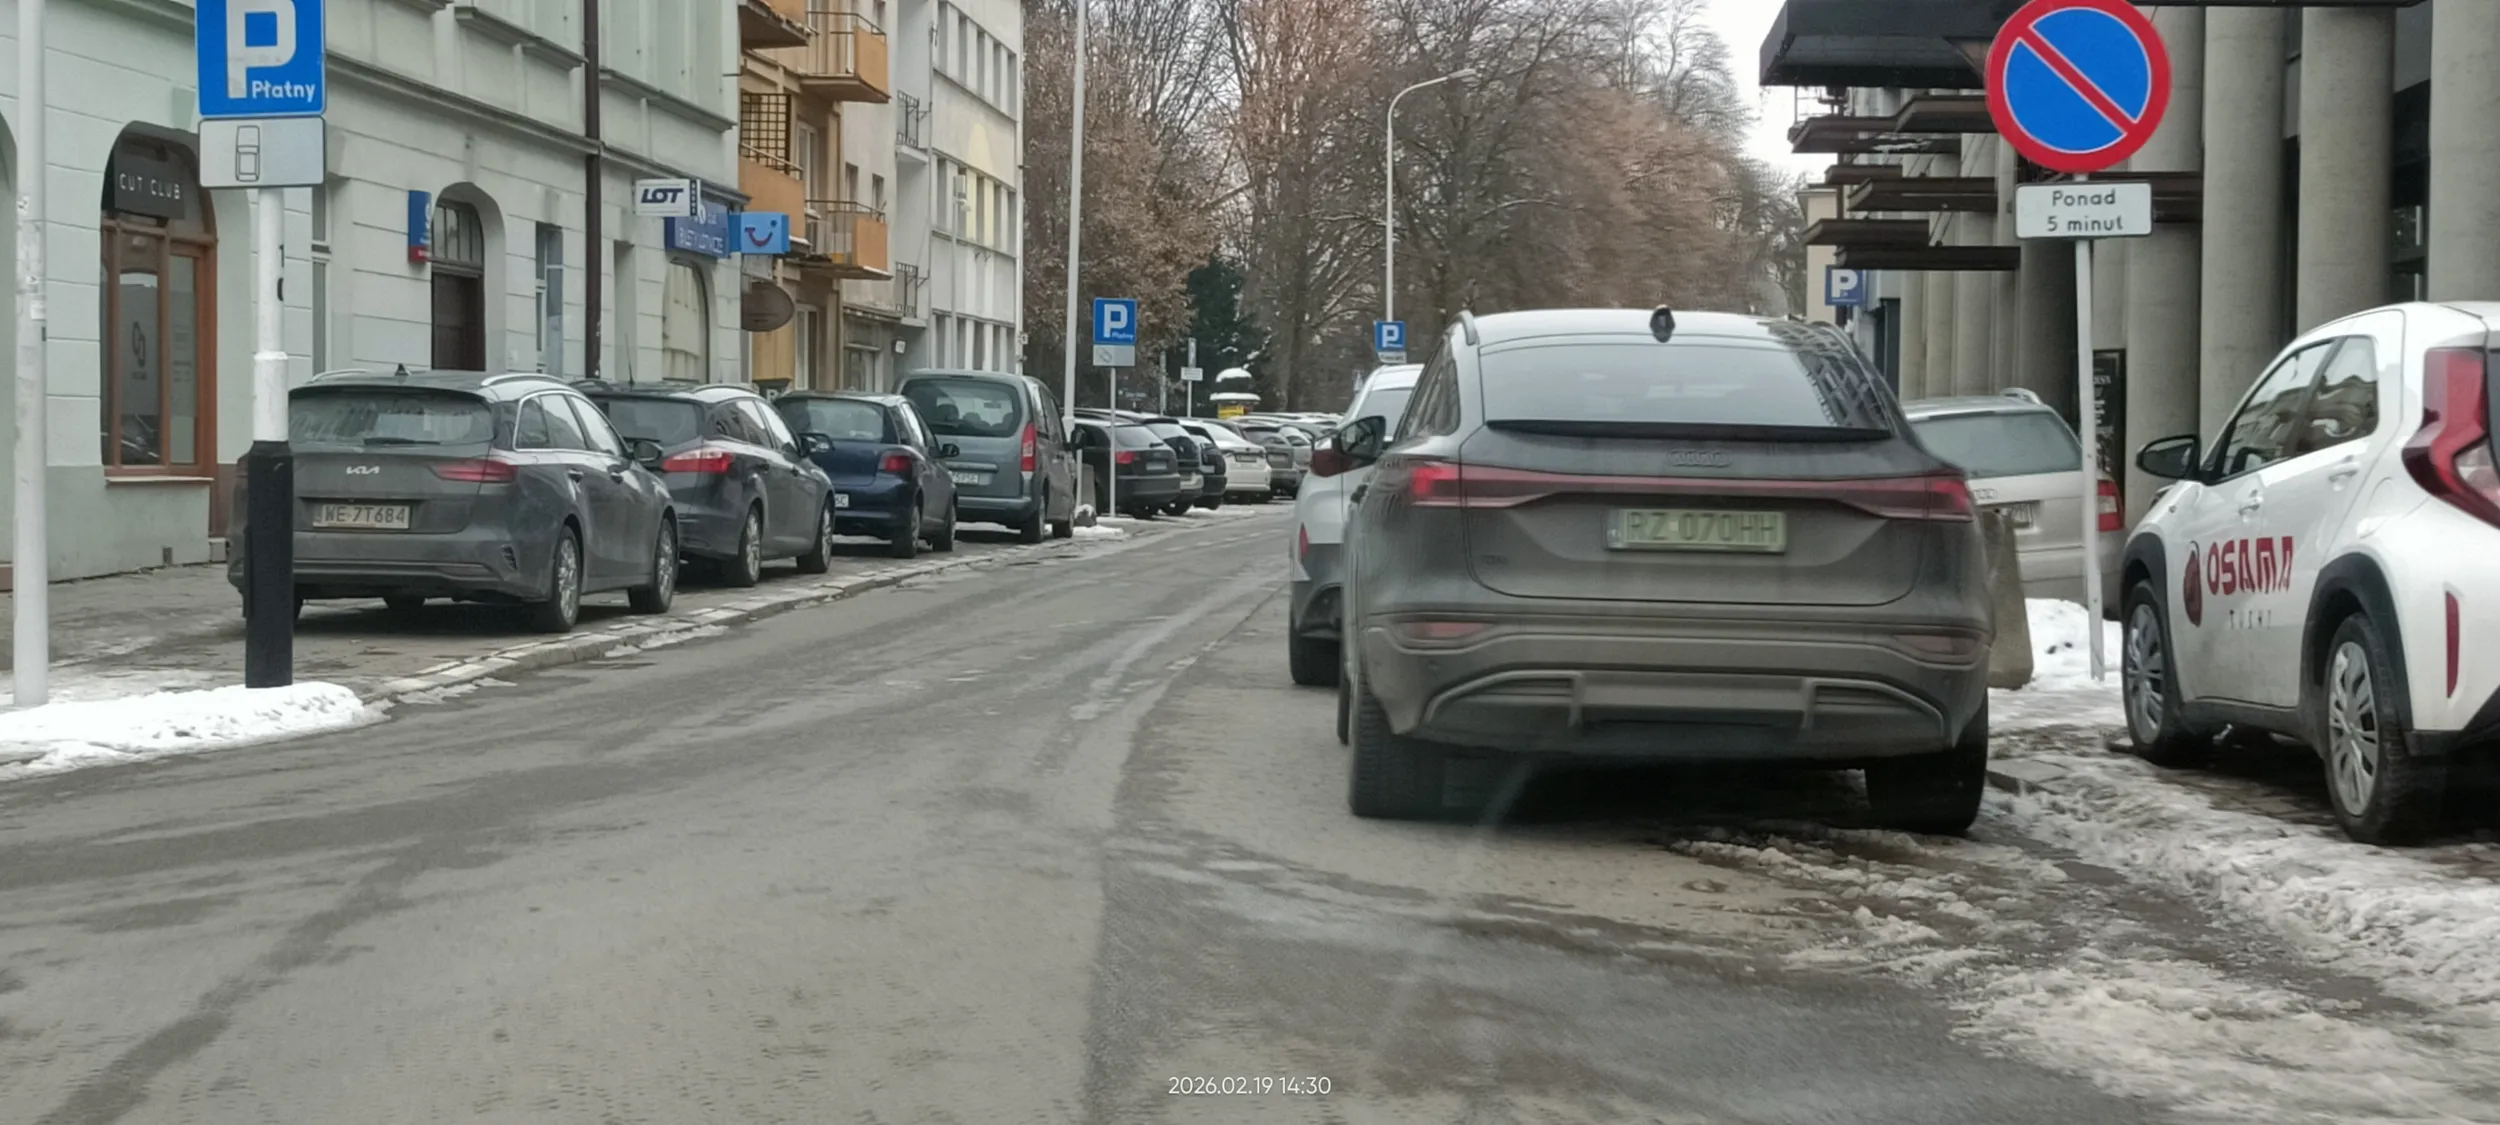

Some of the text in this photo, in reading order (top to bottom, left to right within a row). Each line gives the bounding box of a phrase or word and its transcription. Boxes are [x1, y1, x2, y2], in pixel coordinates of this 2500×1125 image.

[226, 0, 296, 99] P
[252, 80, 315, 103] Płatny
[119, 172, 181, 200] CUT CLUB
[641, 188, 684, 203] LOT
[2052, 188, 2116, 207] Ponad
[2047, 215, 2124, 232] 5 minut
[1831, 269, 1858, 298] P
[1103, 304, 1128, 338] P
[1382, 325, 1399, 348] P
[325, 503, 405, 523] WE 7T684
[1628, 511, 1668, 542] RZ
[2207, 536, 2293, 596] OSAMA
